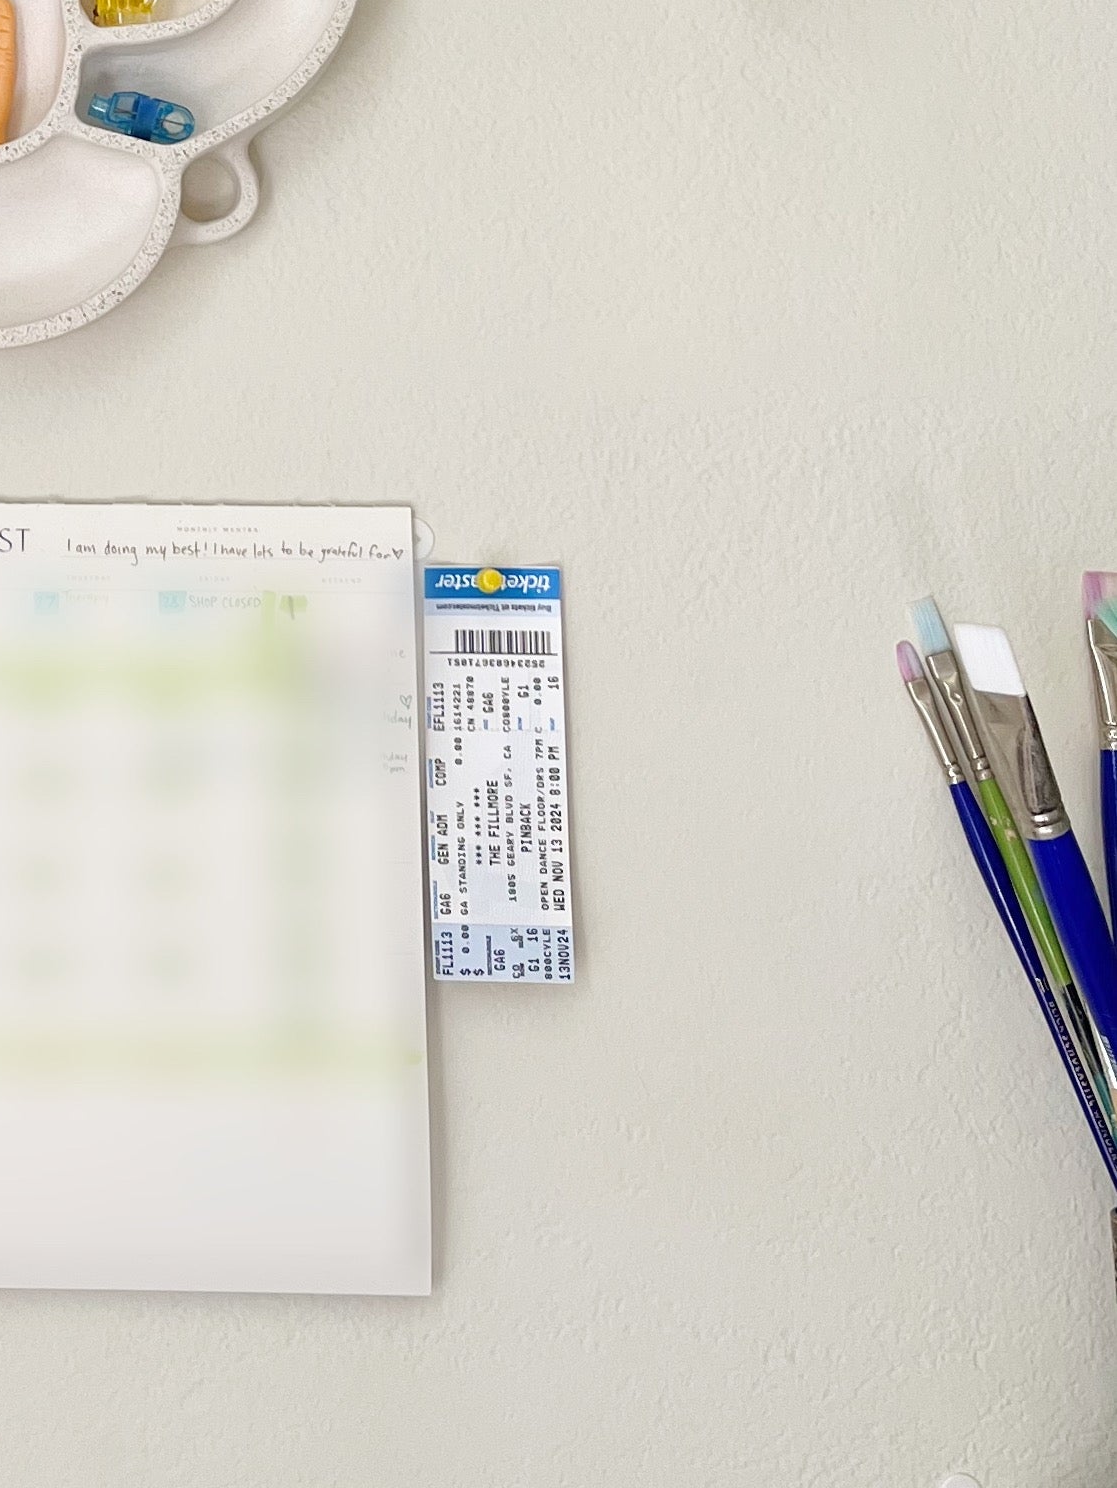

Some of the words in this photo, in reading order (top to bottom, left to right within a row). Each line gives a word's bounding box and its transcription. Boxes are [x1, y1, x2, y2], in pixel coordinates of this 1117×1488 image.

[75, 543, 96, 554] am
[104, 540, 139, 566] doing
[146, 545, 167, 561] my
[172, 540, 208, 558] best!
[220, 542, 248, 557] have
[253, 543, 274, 559] lots
[281, 540, 293, 556] to
[299, 541, 314, 558] be
[317, 541, 363, 563] grateful
[435, 573, 551, 594] ticketaster
[189, 595, 218, 609] SHOP
[222, 596, 262, 609] CLOSED
[548, 676, 560, 690] 16
[433, 682, 446, 732] EFL1113
[453, 683, 462, 731] 1614221
[467, 718, 476, 732] CN
[503, 745, 512, 759] CA
[535, 738, 543, 760] 7PM
[548, 746, 560, 761] PM
[434, 758, 447, 787] COMP
[548, 767, 561, 796] 8:00
[486, 779, 500, 838] FILLMORE
[504, 794, 514, 824] BLVD
[535, 767, 546, 832] FLOOR/DRS
[436, 814, 448, 836] ADM
[455, 801, 465, 830] ONLY
[550, 803, 562, 832] 2024
[519, 803, 533, 853] PINBACK
[438, 843, 450, 865] GEN
[489, 844, 501, 866] THE
[505, 831, 516, 867] GEARY
[538, 838, 548, 875] DANCE
[551, 839, 563, 853] 13
[457, 836, 468, 894] STANDING
[552, 860, 564, 882] NOV
[439, 893, 452, 916] GA6
[540, 881, 550, 911] OPEN
[553, 888, 566, 911] WED
[460, 901, 469, 916] GA
[526, 928, 539, 943] 16
[440, 931, 455, 976] FL1113
[493, 949, 506, 972] GA6
[528, 958, 540, 972] G1
[556, 929, 571, 981] 13NOV24
